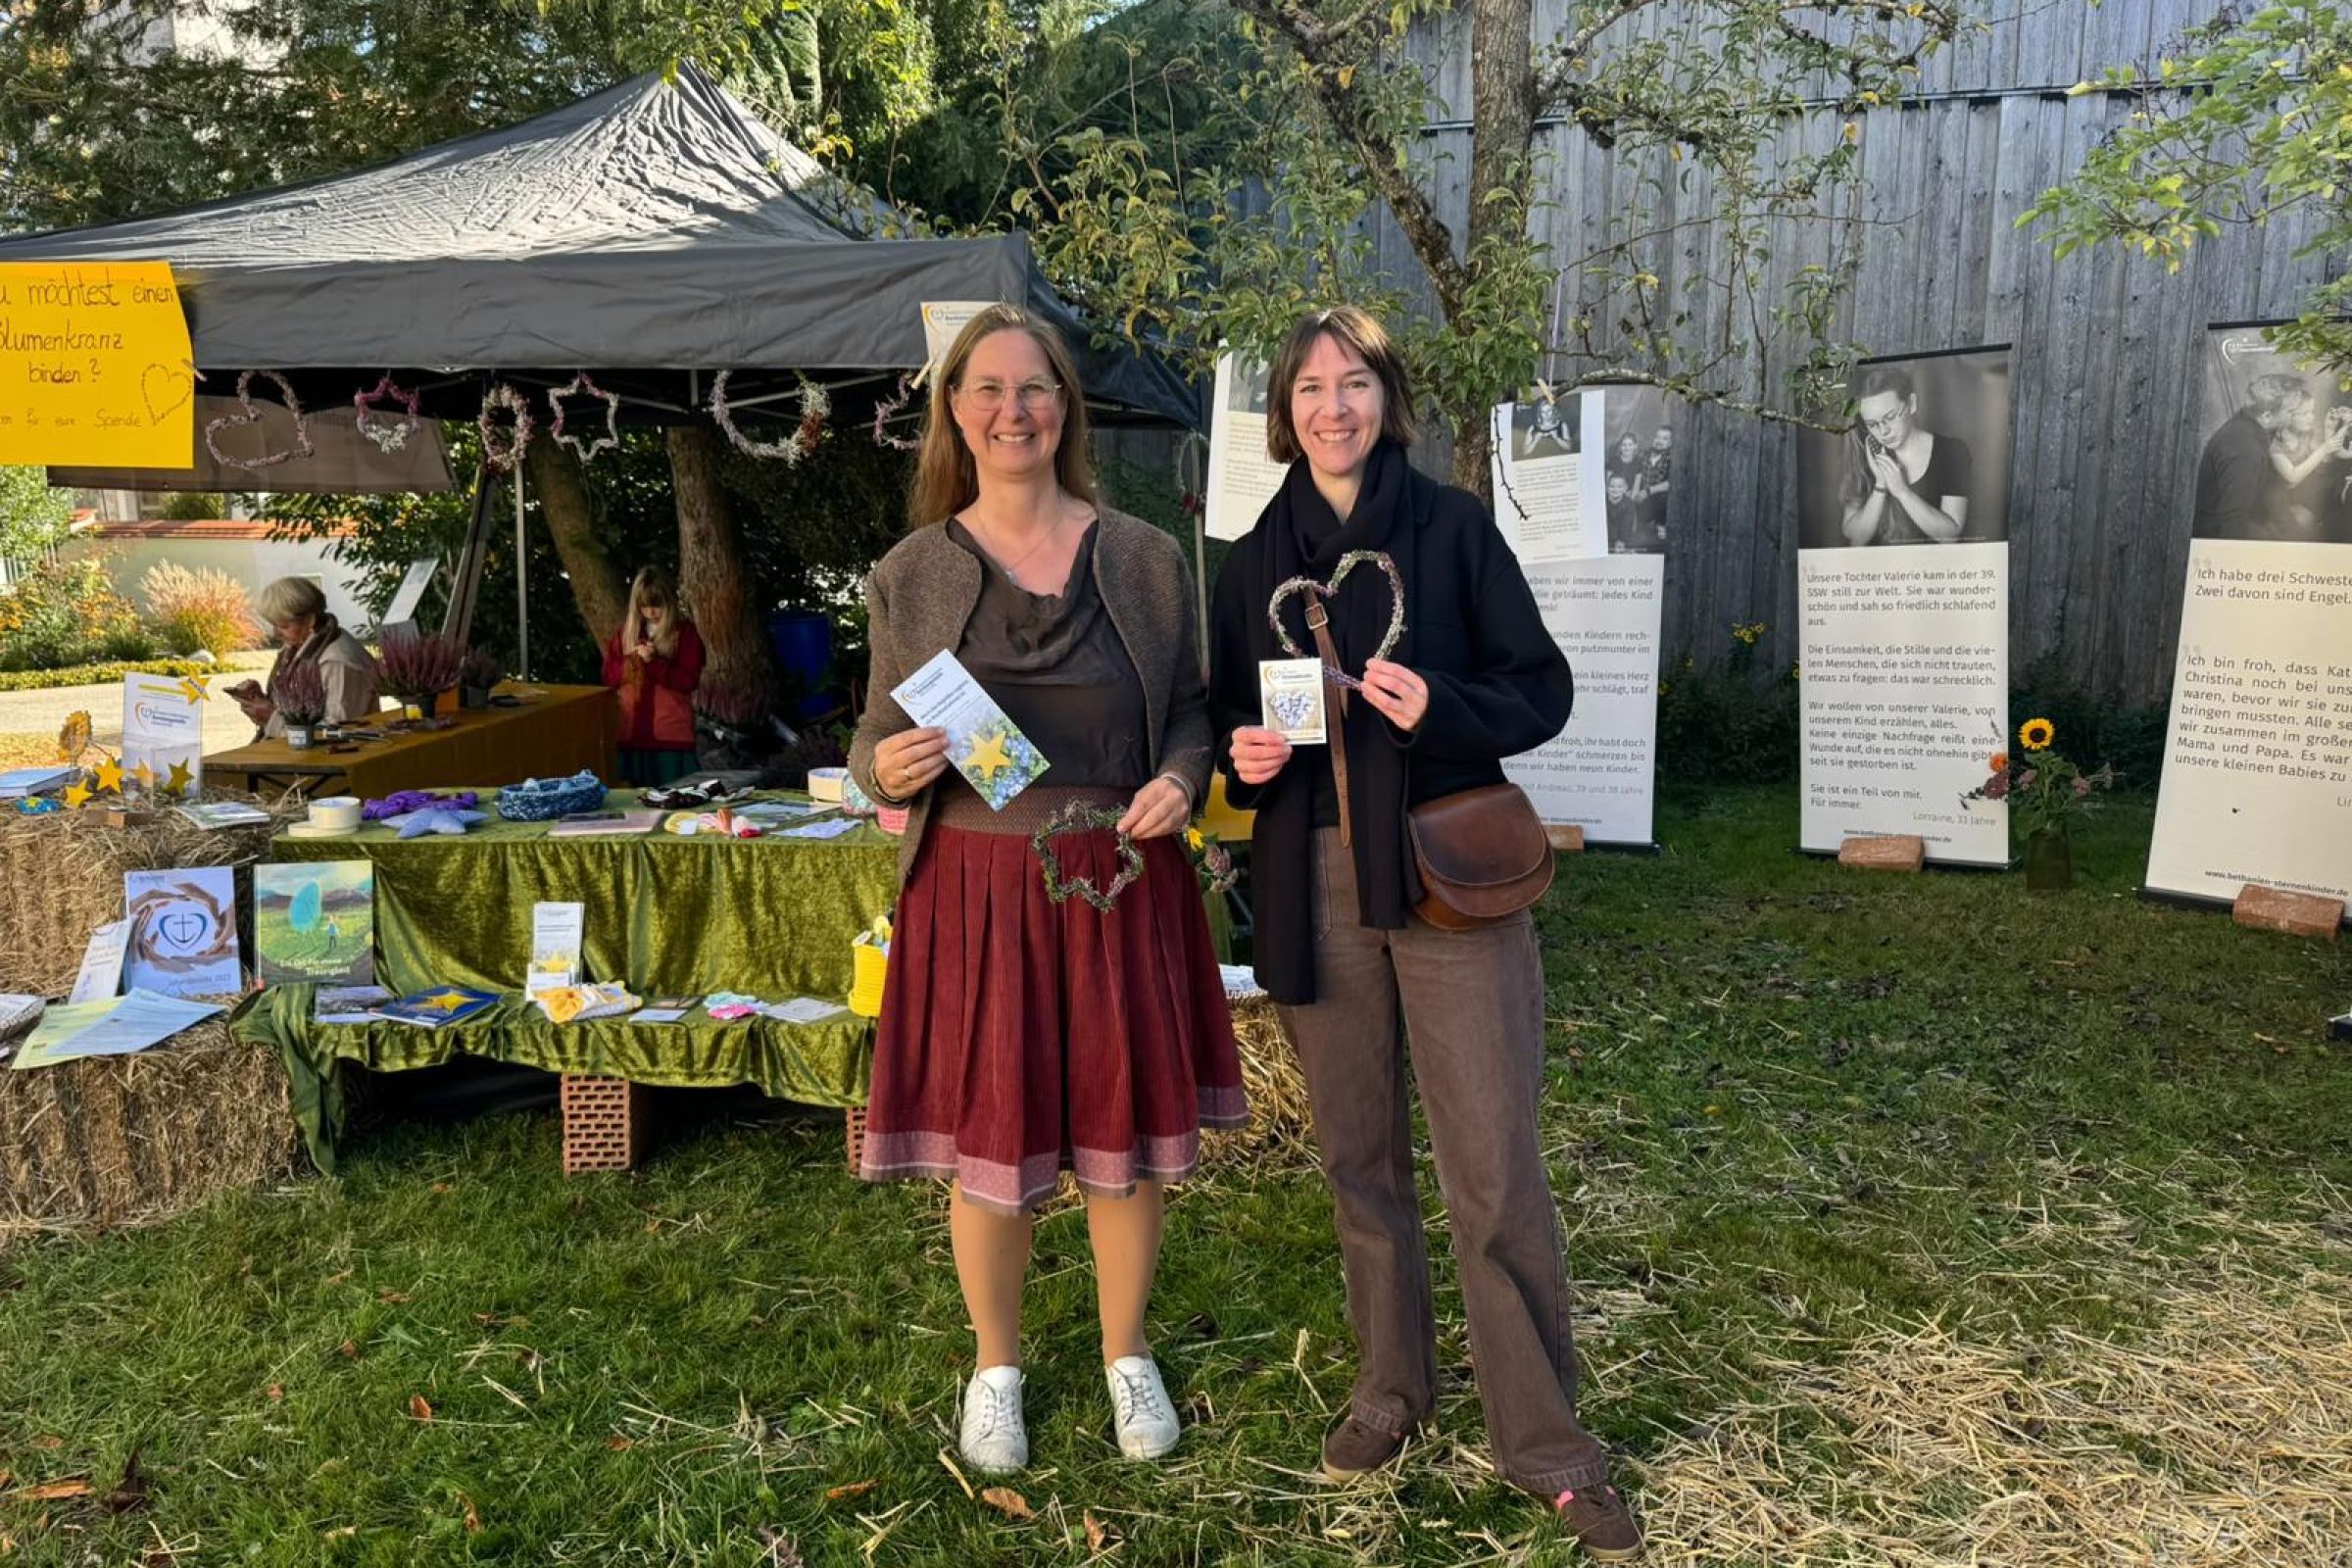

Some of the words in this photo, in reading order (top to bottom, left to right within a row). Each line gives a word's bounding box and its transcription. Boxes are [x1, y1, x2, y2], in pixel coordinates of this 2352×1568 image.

[28, 267, 121, 307] möchtest
[133, 277, 173, 303] einen
[94, 409, 141, 430] Spende
[1629, 576, 1652, 585] einer
[1808, 572, 1840, 582] Unsere
[1845, 572, 1881, 581] Tochter
[1885, 571, 1920, 581] Valerie
[1924, 571, 1944, 580] kam
[1947, 571, 1957, 580] in
[1960, 570, 1977, 579] der
[2197, 568, 2215, 579] Ich
[2220, 569, 2252, 581] habe
[2257, 569, 2284, 582] drei
[1832, 587, 1851, 597] still
[1876, 587, 1900, 596] Welt.
[1906, 586, 1922, 595] Sie
[1949, 585, 1995, 595] wunder-
[2195, 585, 2223, 596] Zwei
[2229, 587, 2269, 599] davon
[2275, 589, 2304, 601] sind
[2310, 591, 2351, 605] Engel.
[1808, 602, 1836, 611] schön
[1839, 601, 1858, 611] und
[1862, 601, 1879, 611] sah
[1896, 600, 1939, 610] friedlich
[1942, 600, 1995, 610] schlafend
[1808, 645, 1823, 654] Die
[1826, 645, 1883, 656] Einsamkeit,
[1886, 645, 1901, 655] die
[1904, 645, 1930, 655] Stille
[1934, 645, 1952, 655] und
[1955, 645, 1971, 655] die
[1975, 646, 1995, 655] vie-
[1808, 659, 1823, 667] len
[1826, 659, 1879, 669] Menschen,
[1882, 659, 1897, 668] die
[1901, 659, 1921, 668] sich
[1925, 660, 1949, 669] nicht
[1952, 661, 1995, 671] trauten,
[2187, 655, 2205, 665] Ich
[2214, 657, 2235, 668] bin
[2244, 659, 2277, 673] froh,
[2285, 662, 2318, 675] dass
[1591, 670, 1625, 680] kleines
[1808, 673, 1836, 682] etwas
[1890, 673, 1909, 683] das
[1933, 674, 1995, 685] schrecklich.
[2185, 671, 2242, 686] Christina
[2252, 677, 2286, 689] noch
[2296, 680, 2318, 692] bei
[2183, 689, 2226, 703] waren,
[2232, 692, 2272, 705] bevor
[2278, 697, 2300, 708] wir
[2307, 698, 2327, 710] sie
[1828, 702, 1861, 710] wollen
[1932, 705, 1971, 715] Valerie,
[1855, 716, 1876, 726] Kind
[1881, 717, 1928, 728] erzählen,
[1931, 719, 1957, 729] alles.
[2181, 705, 2230, 719] bringen
[2237, 710, 2298, 725] mussten.
[2305, 716, 2331, 728] Alle
[1809, 729, 1835, 738] Keine
[1842, 730, 1877, 741] einzige
[1883, 732, 1935, 743] Nachfrage
[1940, 734, 1966, 744] reißt
[1972, 736, 1995, 745] eine
[2180, 721, 2197, 732] wir
[2203, 724, 2277, 740] zusammen
[2283, 730, 2299, 742] im
[1576, 751, 1626, 760] schmerzen
[1809, 743, 1842, 752] Wunde
[1866, 745, 1881, 755] die
[1898, 746, 1923, 756] nicht
[1927, 749, 1968, 758] ohnehin
[2177, 737, 2215, 751] Mama
[2223, 743, 2248, 754] und
[2256, 745, 2293, 760] Papa.
[2301, 750, 2316, 761] Es
[2324, 754, 2349, 764] war
[1811, 757, 1827, 765] seit
[1831, 758, 1844, 766] sie
[1847, 760, 1898, 769] gestorben
[2176, 755, 2219, 767] unsere
[2224, 758, 2274, 773] kleinen
[2278, 764, 2326, 780] Babies
[2329, 771, 2345, 782] zu
[1811, 784, 1825, 793] Sie
[1829, 785, 1839, 794] ist
[1843, 786, 1858, 795] ein
[1861, 786, 1879, 796] Teil
[1811, 798, 1825, 807] Für
[1971, 815, 1995, 826] Jahre
